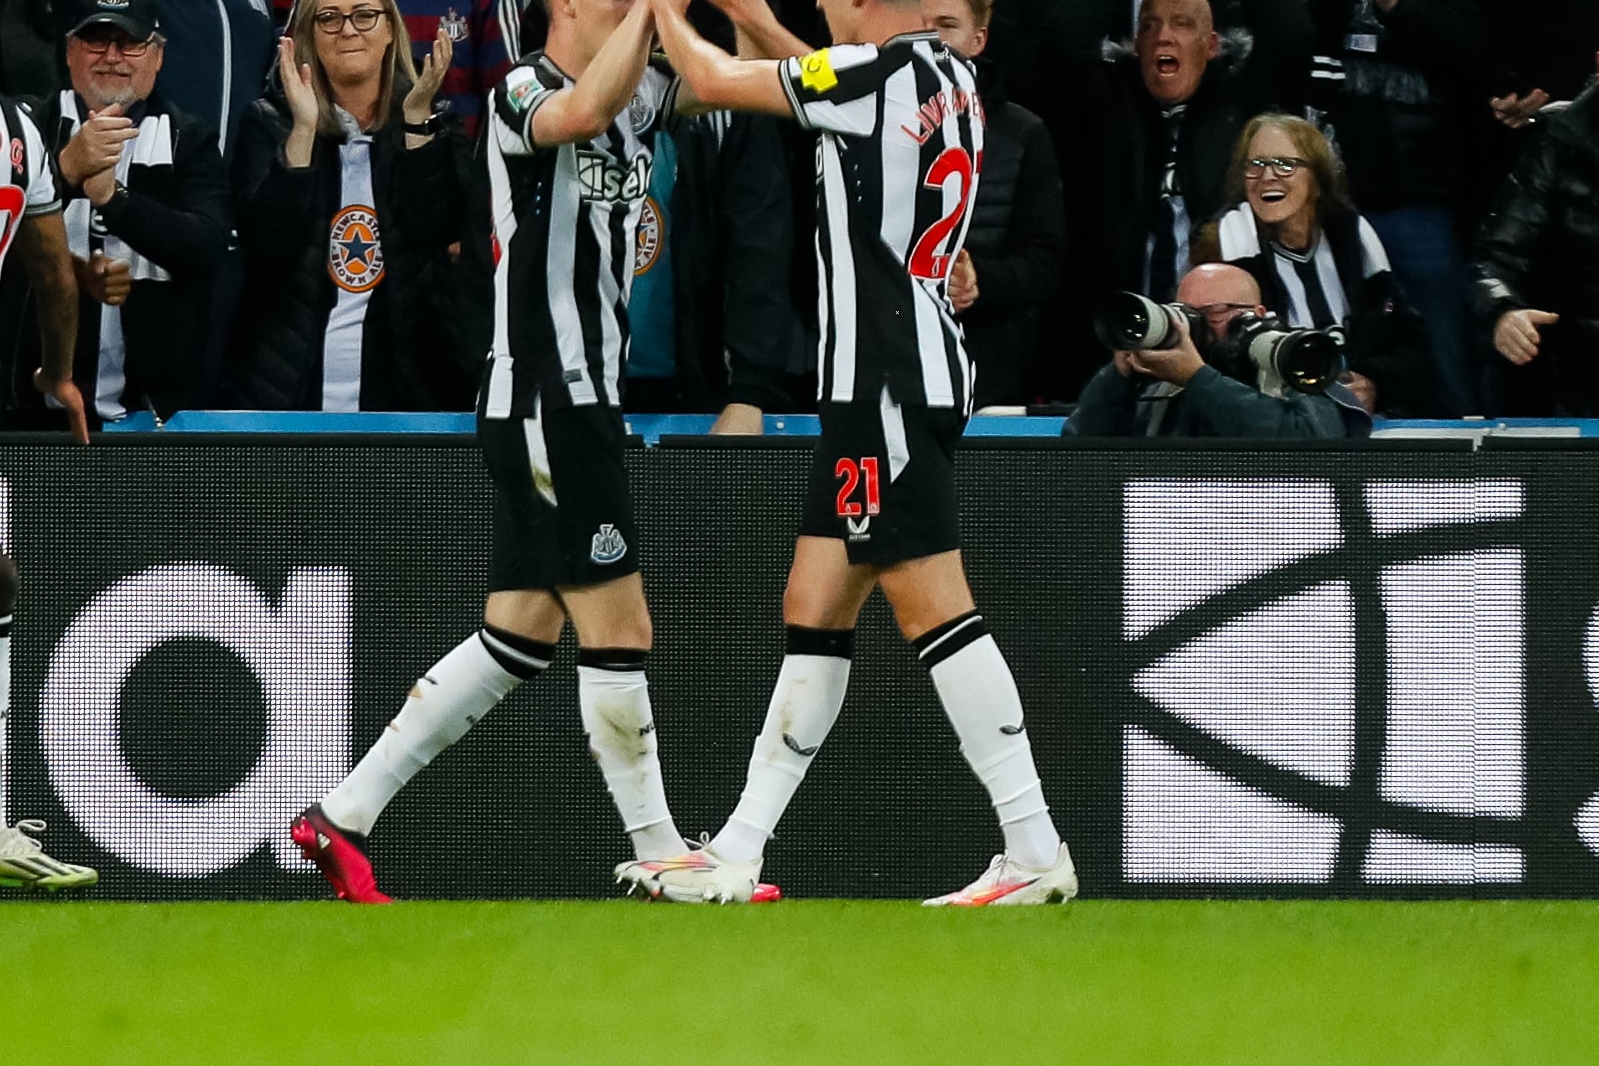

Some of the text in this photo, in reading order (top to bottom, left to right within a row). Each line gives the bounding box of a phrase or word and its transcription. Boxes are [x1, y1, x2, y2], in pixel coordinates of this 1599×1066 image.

[603, 156, 648, 201] sel
[908, 146, 983, 280] 2
[331, 253, 367, 285] BROWN
[834, 456, 881, 516] 21
